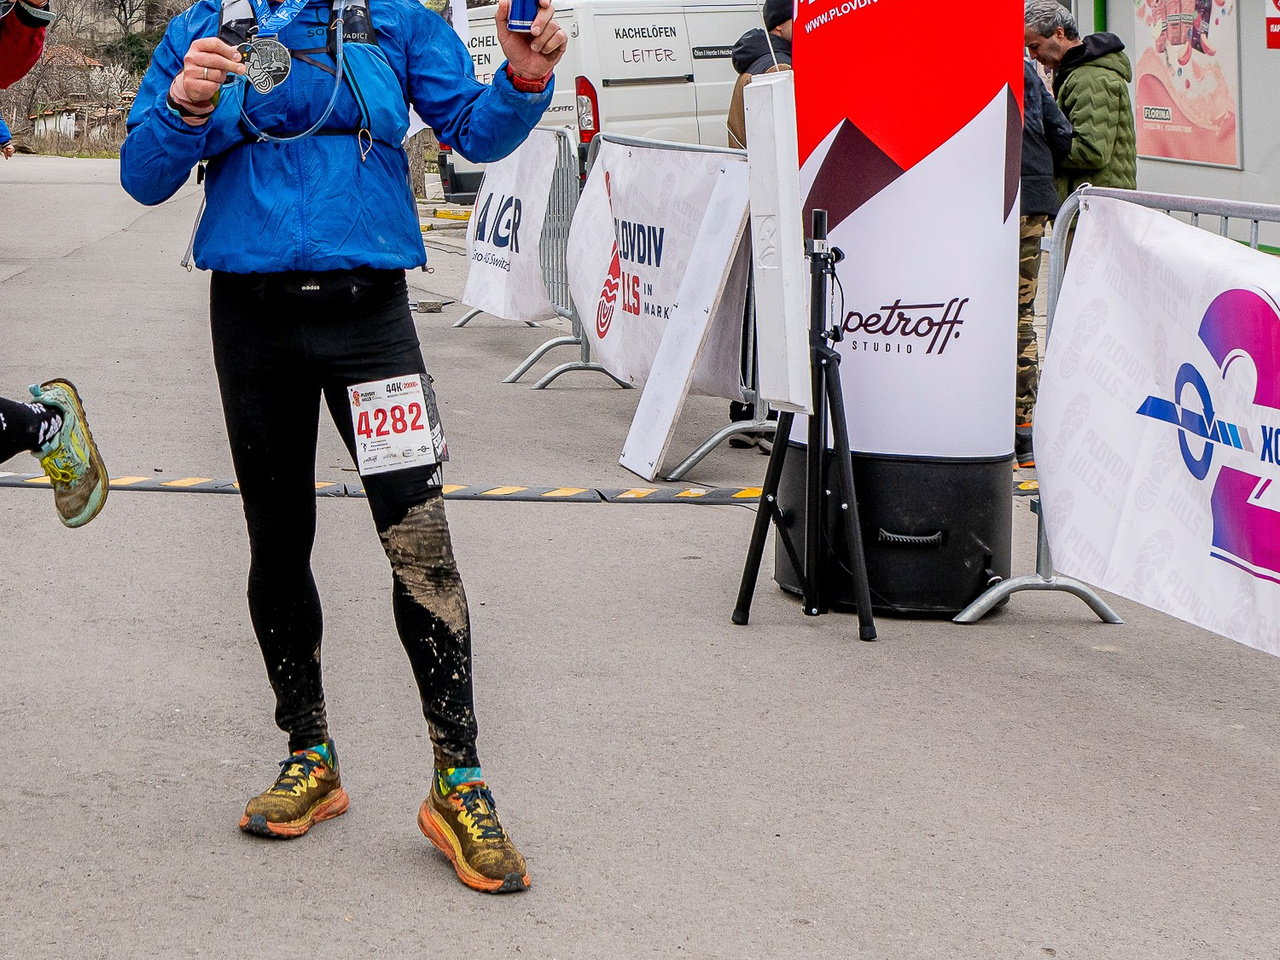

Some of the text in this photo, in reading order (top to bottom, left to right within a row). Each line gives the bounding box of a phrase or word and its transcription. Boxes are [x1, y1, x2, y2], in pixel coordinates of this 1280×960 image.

[614, 25, 677, 39] KACHELÖFEN
[621, 48, 677, 64] LEITER
[622, 271, 653, 316] LLS IN
[644, 301, 671, 320] MARK
[852, 340, 912, 354] STUDIO
[357, 402, 424, 439] 4282
